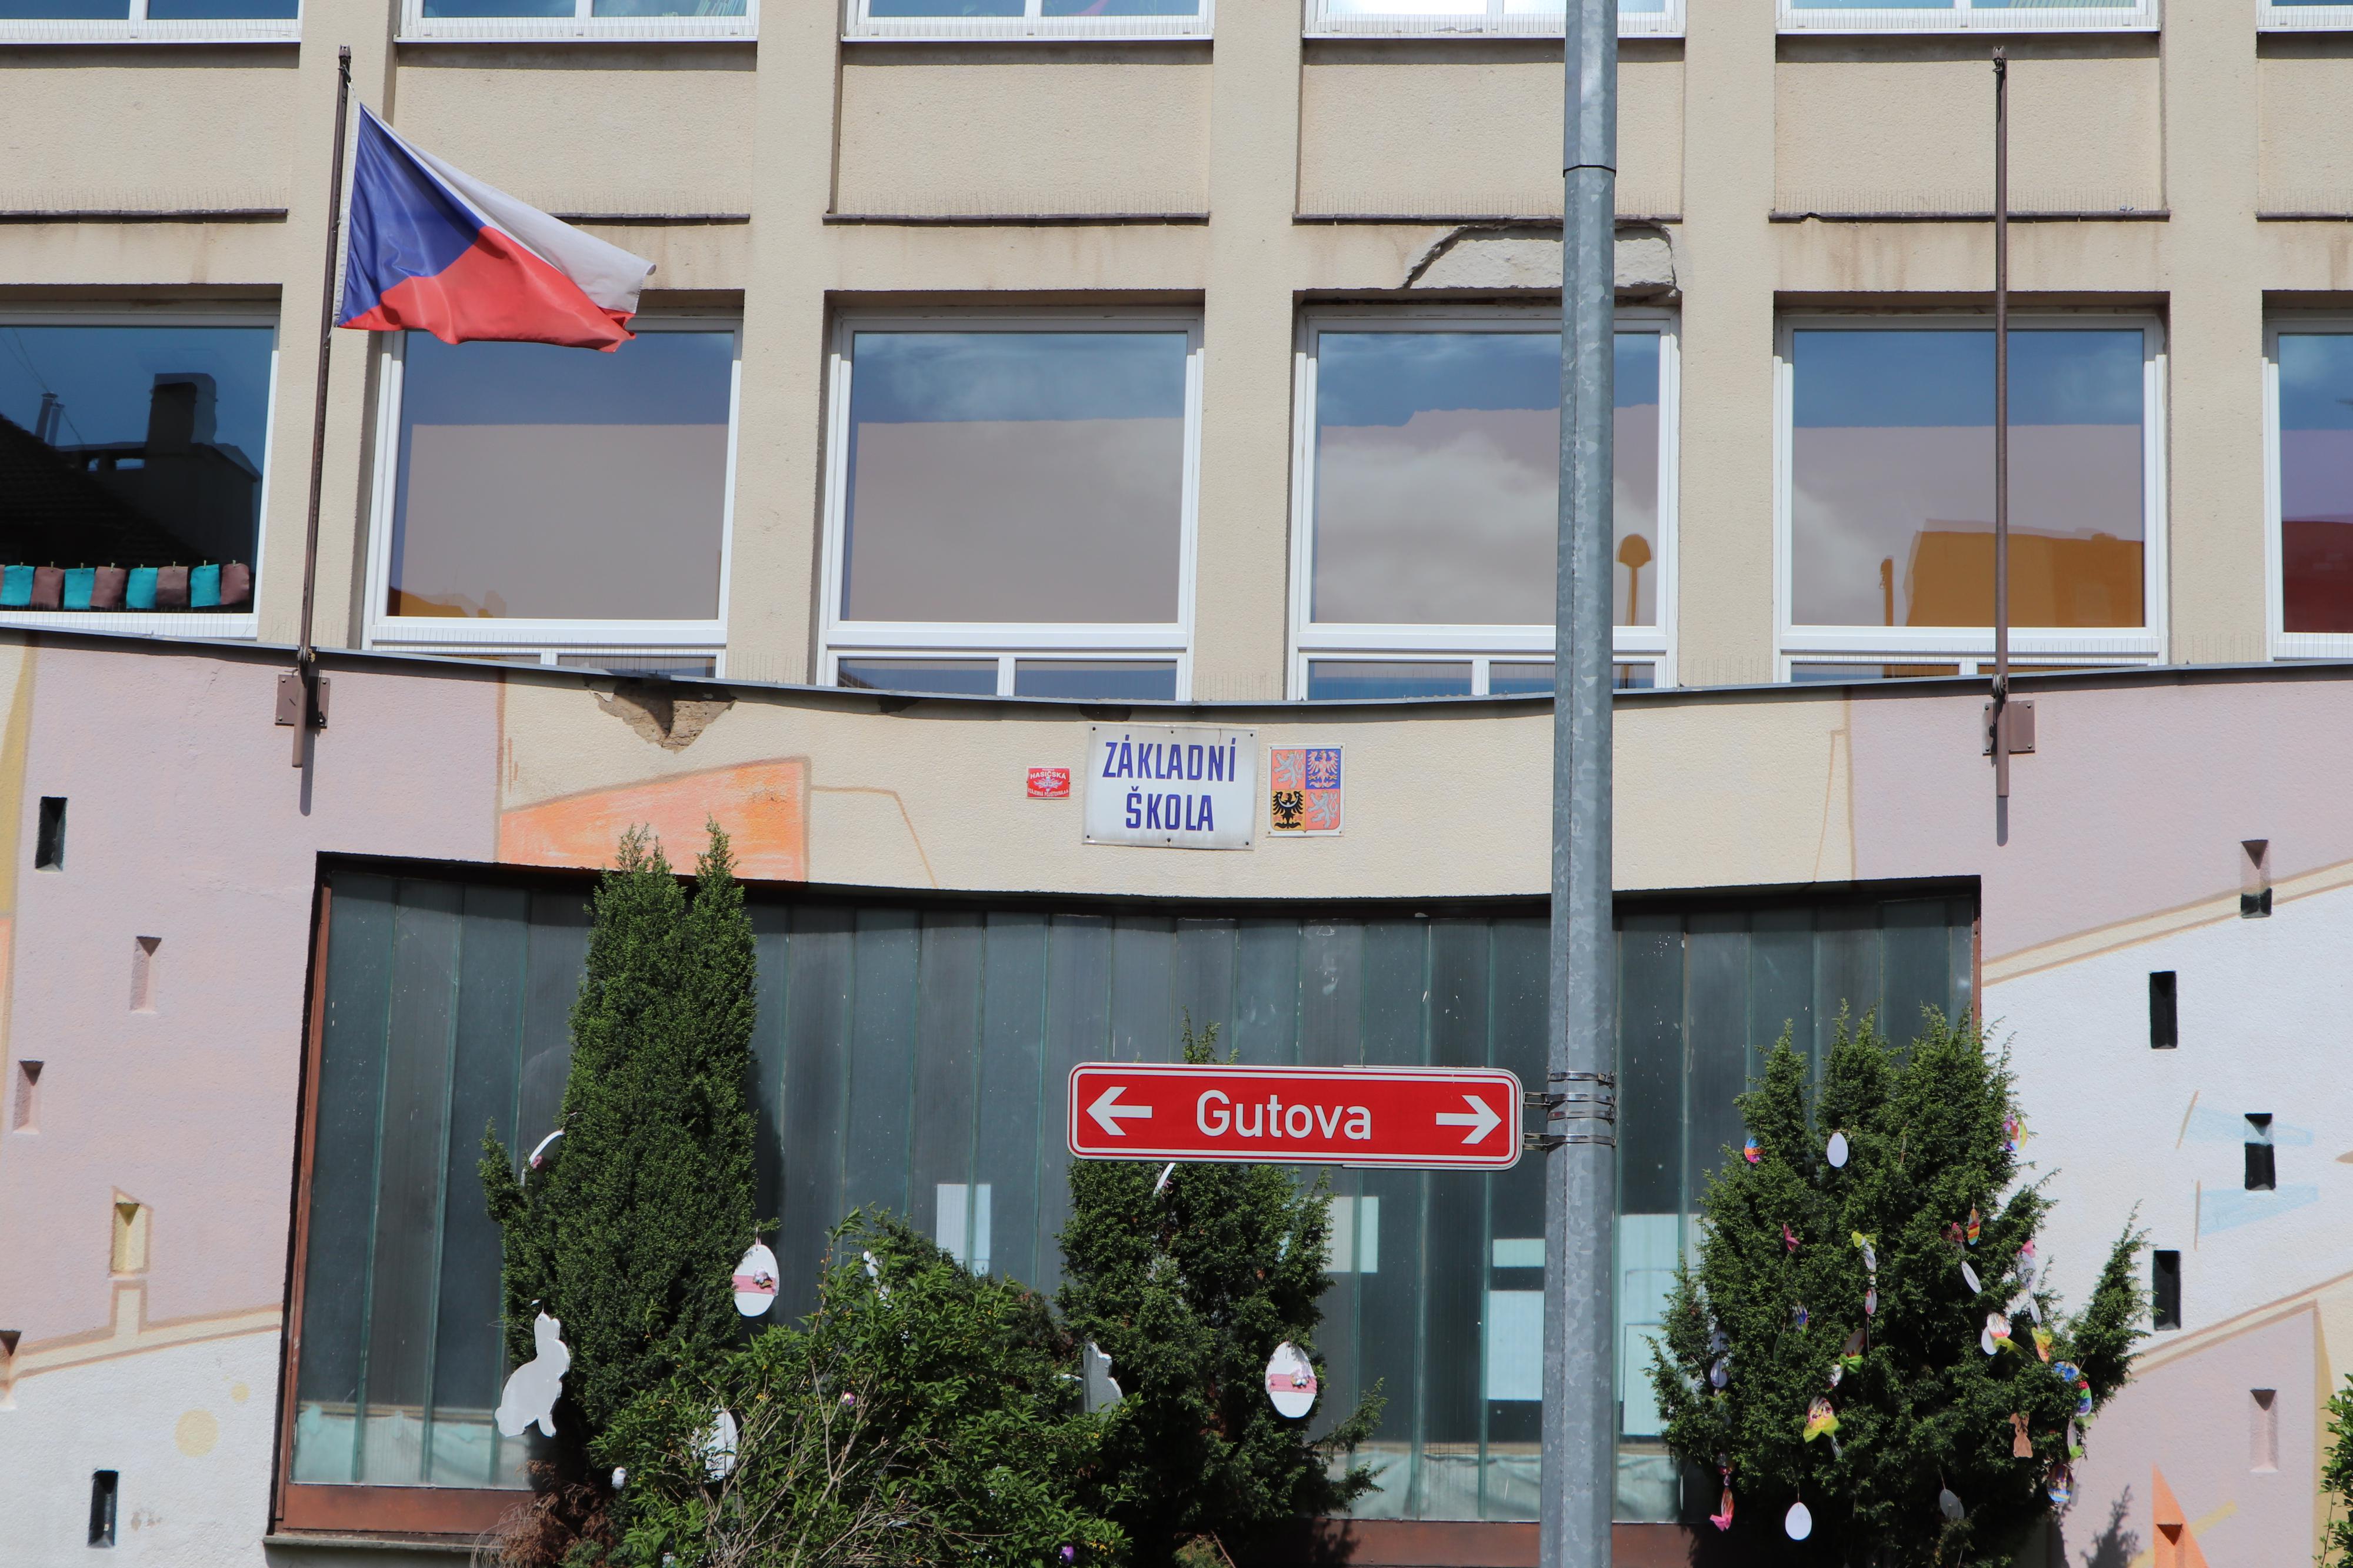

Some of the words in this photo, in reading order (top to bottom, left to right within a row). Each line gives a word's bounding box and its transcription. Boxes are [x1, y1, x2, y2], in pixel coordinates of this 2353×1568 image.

[1030, 770, 1066, 779] HASIČSKÁ
[1102, 734, 1237, 782] ZÁKLADNÍ
[1125, 785, 1214, 832] ŠKOLA
[1195, 1089, 1372, 1140] Gutova
